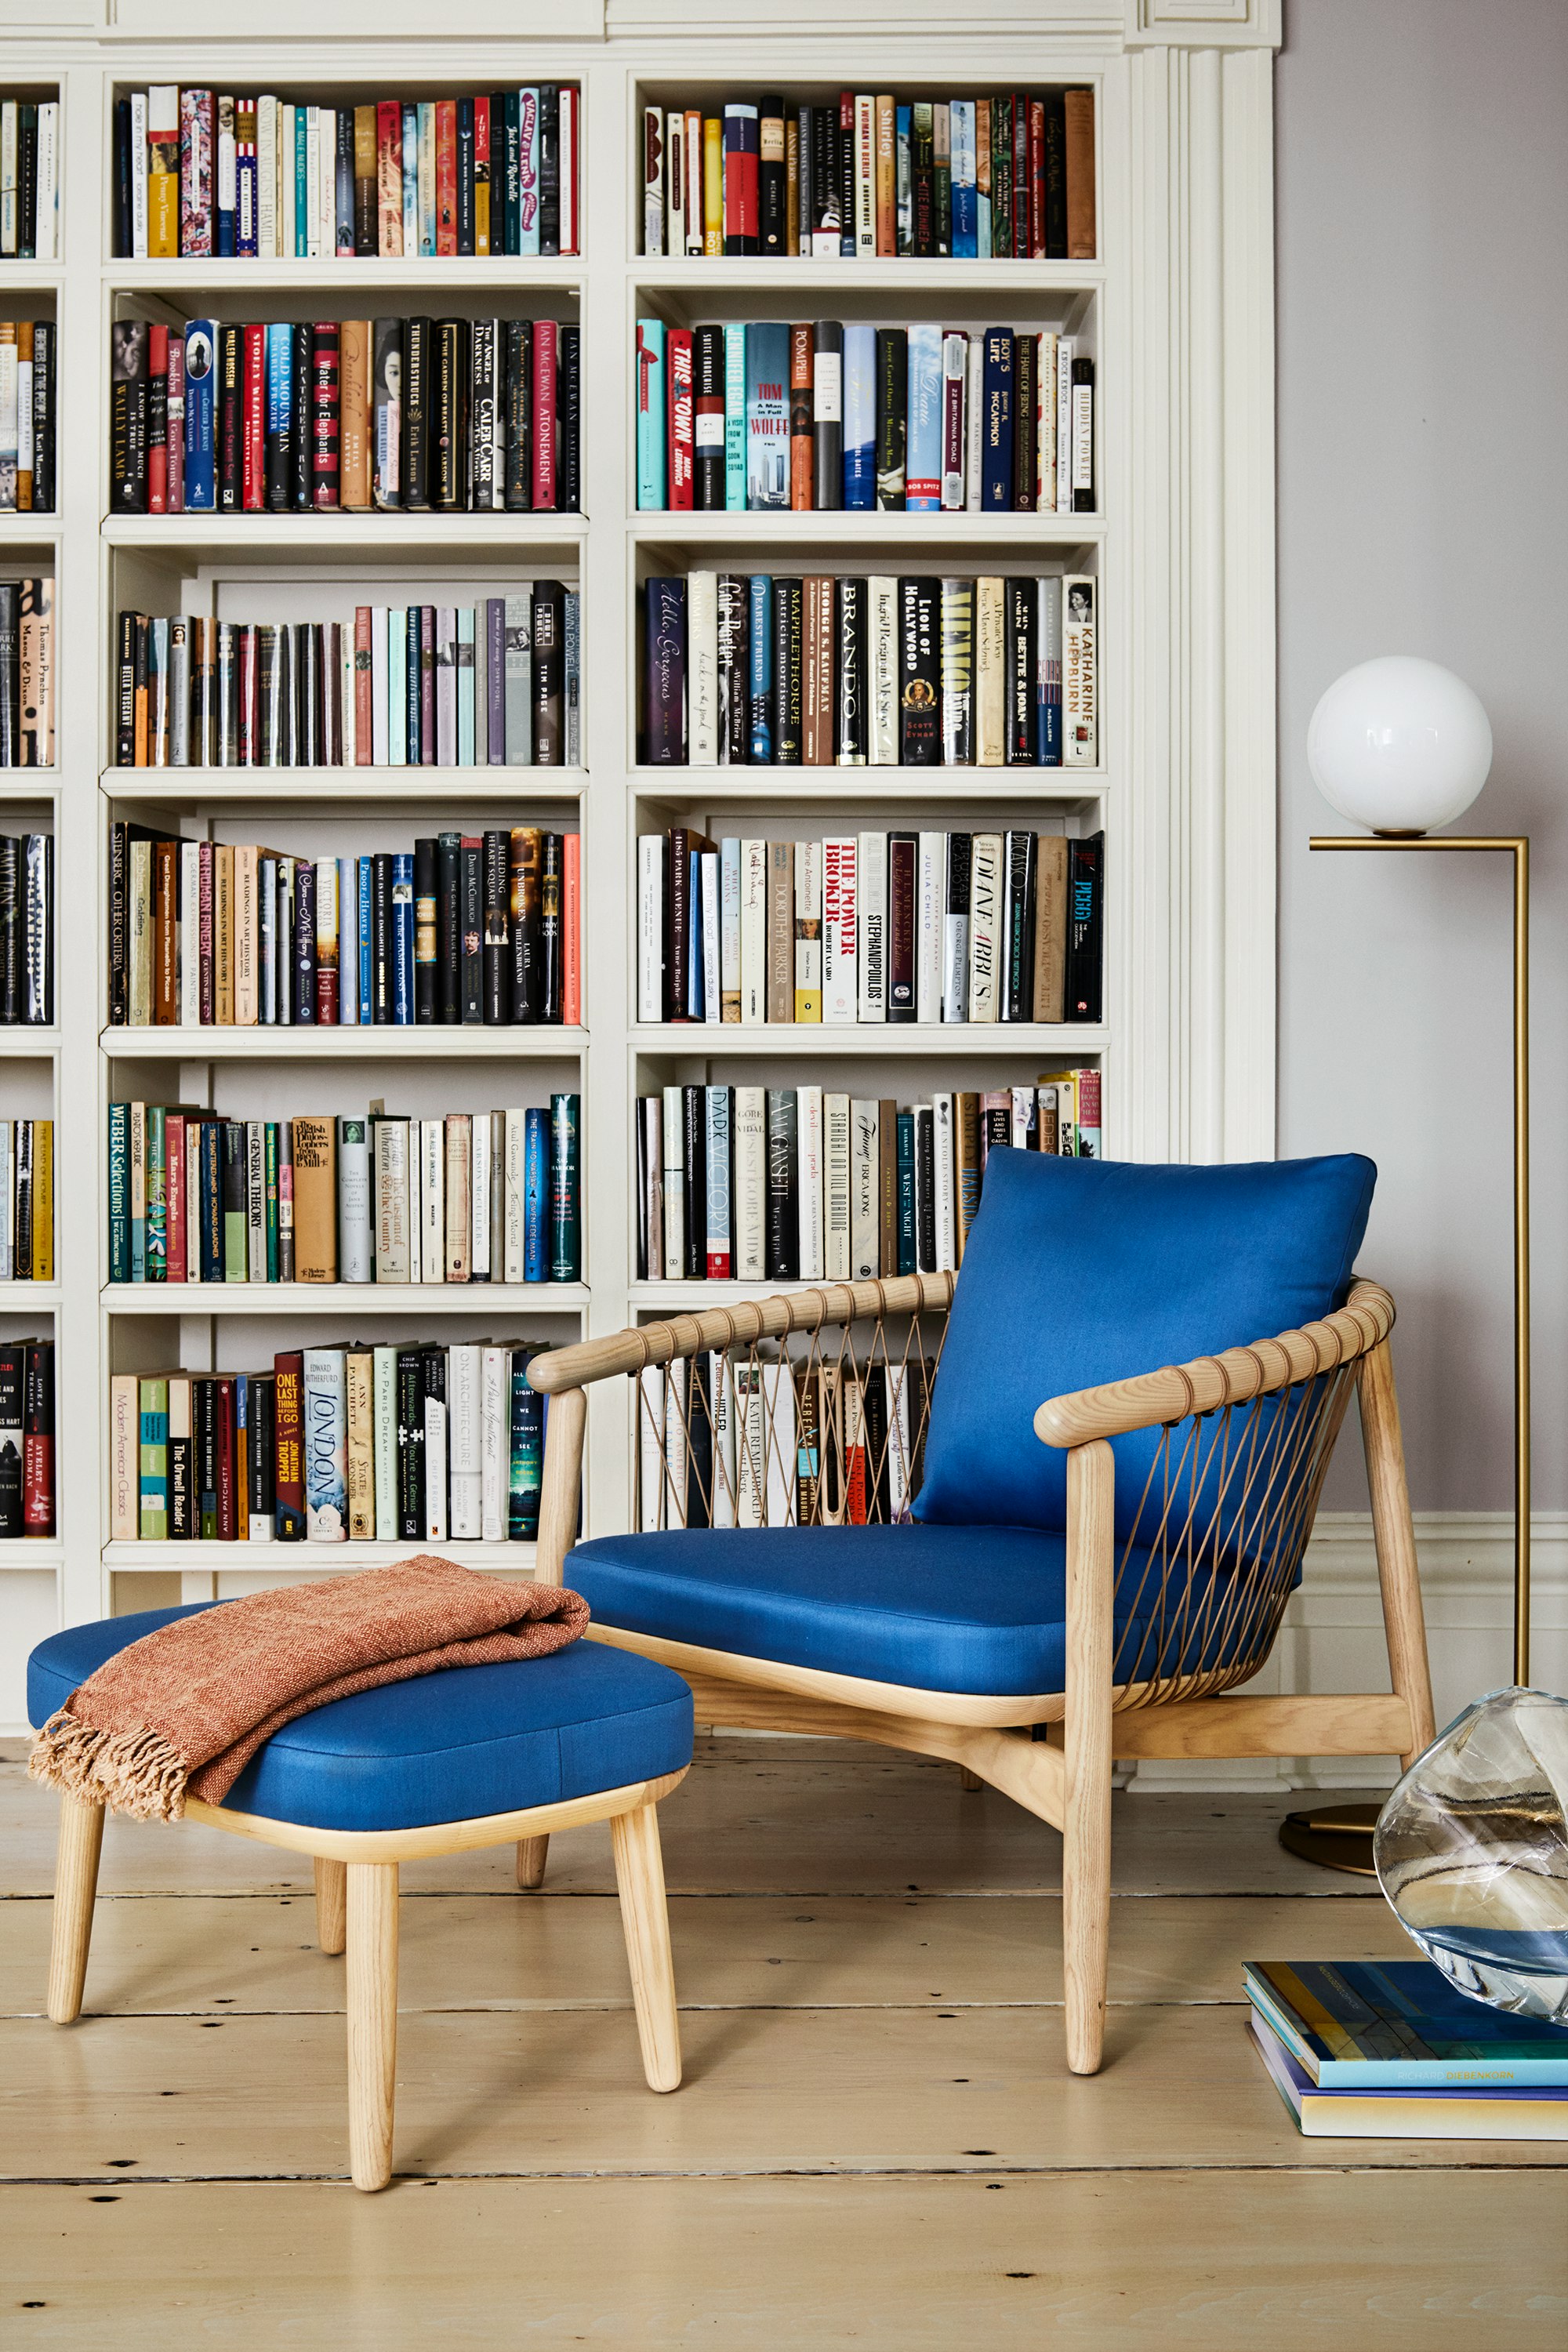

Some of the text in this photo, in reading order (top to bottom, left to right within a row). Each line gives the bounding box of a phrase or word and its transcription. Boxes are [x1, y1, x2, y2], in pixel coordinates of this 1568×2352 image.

[135, 104, 144, 123] hole
[506, 126, 517, 144] Jack
[521, 100, 535, 139] VACLAV
[879, 110, 893, 158] Shirley
[135, 136, 143, 149] my
[136, 151, 144, 174] heart
[521, 153, 531, 182] LENA
[158, 176, 168, 203] Penny
[507, 164, 517, 201] Rochelle
[169, 348, 180, 392] Brooklyn
[411, 325, 420, 405] THUNDERSTRUCK
[540, 351, 550, 401] McEWAN
[728, 329, 743, 415] JENNIFER EGAN
[130, 412, 136, 421] IS
[318, 361, 330, 463] Water for Elephants
[675, 347, 691, 444] THIS TOWN
[115, 384, 125, 479] WALLY LAMB
[481, 398, 493, 481] CALEB CARR
[540, 408, 550, 484] ATONEMENT
[718, 583, 741, 666] Cole Porter
[779, 590, 788, 645] patricia
[822, 638, 829, 648] S.
[905, 586, 917, 670] HOLLYWOOD
[920, 600, 931, 655] LION OF
[23, 661, 31, 673] &
[38, 624, 49, 705] Thomas Pynchon
[655, 636, 680, 702] Gorgeous
[791, 590, 800, 724] MAPPLETHORPE
[843, 586, 855, 718] BRANDO
[1068, 636, 1078, 713] HEPBURN
[1083, 629, 1093, 721] KATHARINE
[114, 833, 122, 884] STEINBERG
[826, 844, 840, 922] BROKER
[517, 868, 525, 922] UNBROKEN
[841, 841, 855, 955] THE POWER
[1074, 880, 1092, 922] PEGGY
[113, 891, 122, 971] OTHER CRITERIA
[775, 884, 786, 984] DOROTHY PARKER
[868, 916, 881, 998] STEPHANOPOULOS
[112, 1105, 124, 1214] WEBER Selections
[708, 1092, 728, 1236] DARK VICTORY
[831, 1113, 846, 1230] STRAIGHT ON TILL MORNING
[251, 1185, 261, 1229] THEORY
[509, 1194, 517, 1216] Being
[278, 1374, 296, 1388] ONE
[278, 1388, 297, 1399] LAST
[117, 1395, 129, 1516] Modern American Classics
[279, 1441, 289, 1482] TROPPER
[289, 1441, 298, 1482] JONATHAN
[308, 1390, 338, 1495] LONDON
[409, 1445, 418, 1472] You're
[174, 1445, 185, 1526] The Orwell Reader
[1398, 2071, 1514, 2081] RICHARD DIEBENKORN
